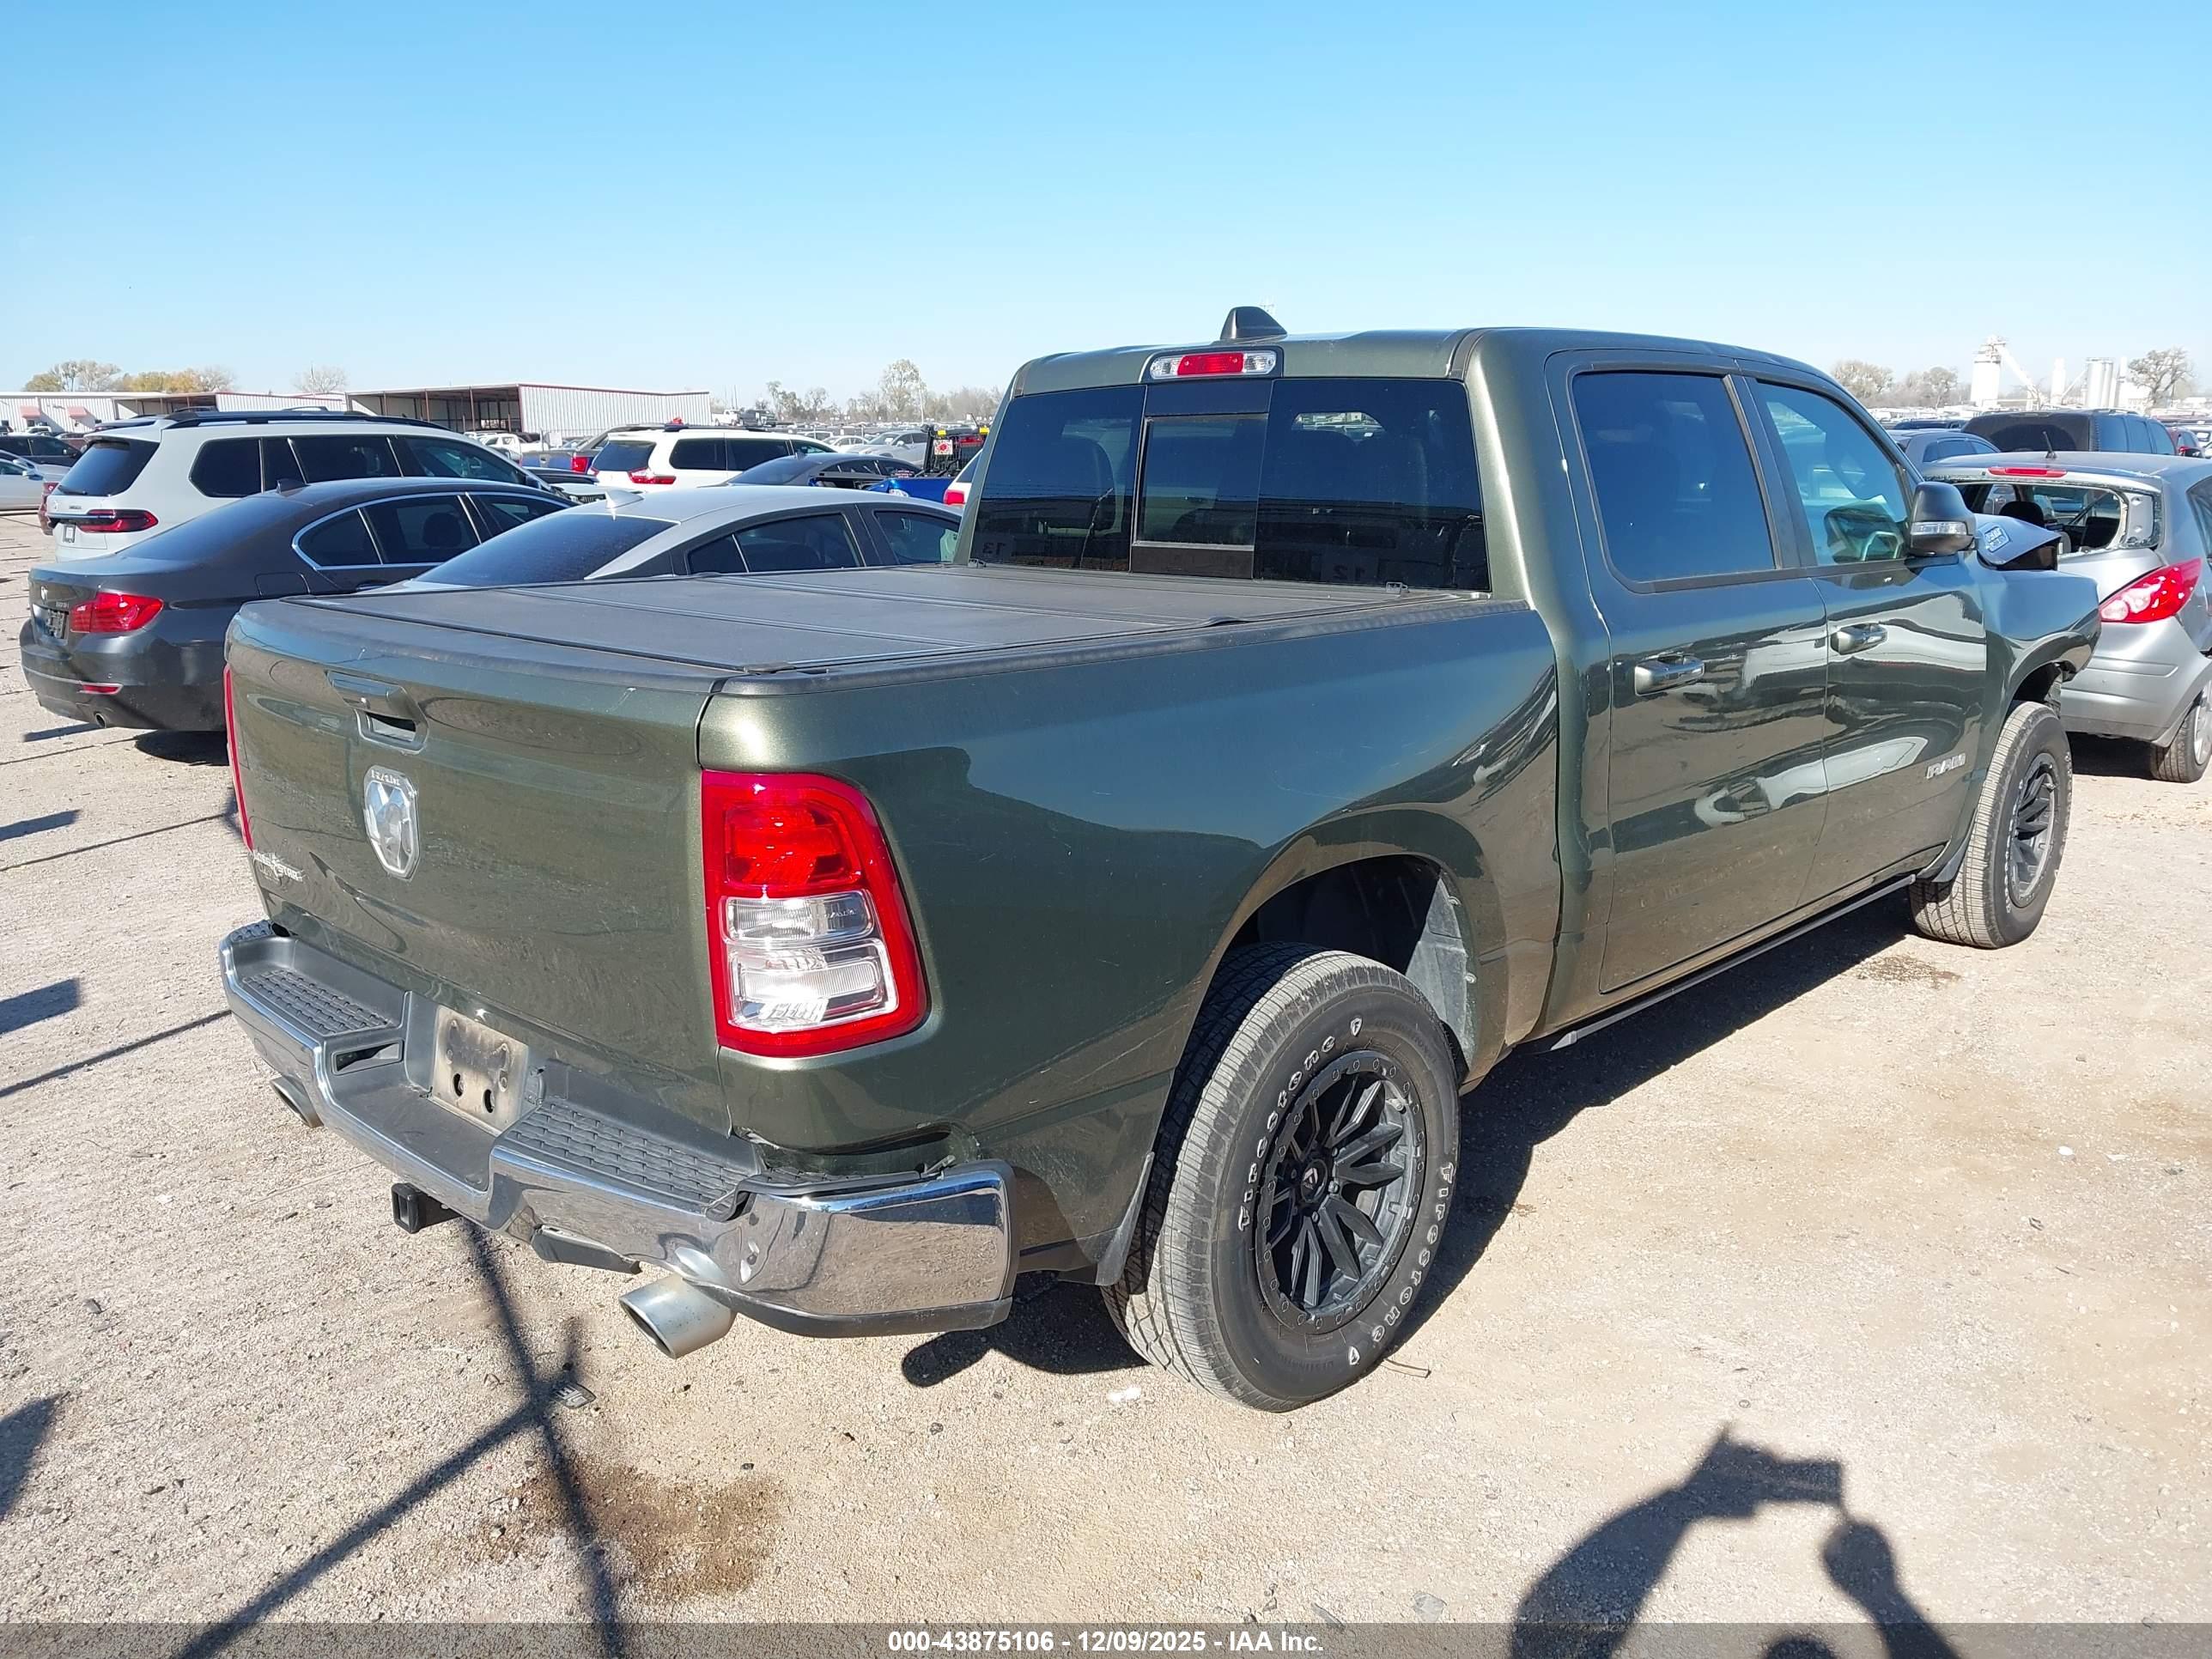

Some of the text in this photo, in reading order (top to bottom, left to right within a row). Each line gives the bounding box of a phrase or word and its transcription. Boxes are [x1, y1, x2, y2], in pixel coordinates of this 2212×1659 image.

[1926, 752, 1966, 780] RAM
[1238, 1036, 1335, 1231] Firestone
[1372, 1162, 1455, 1342] Firestone
